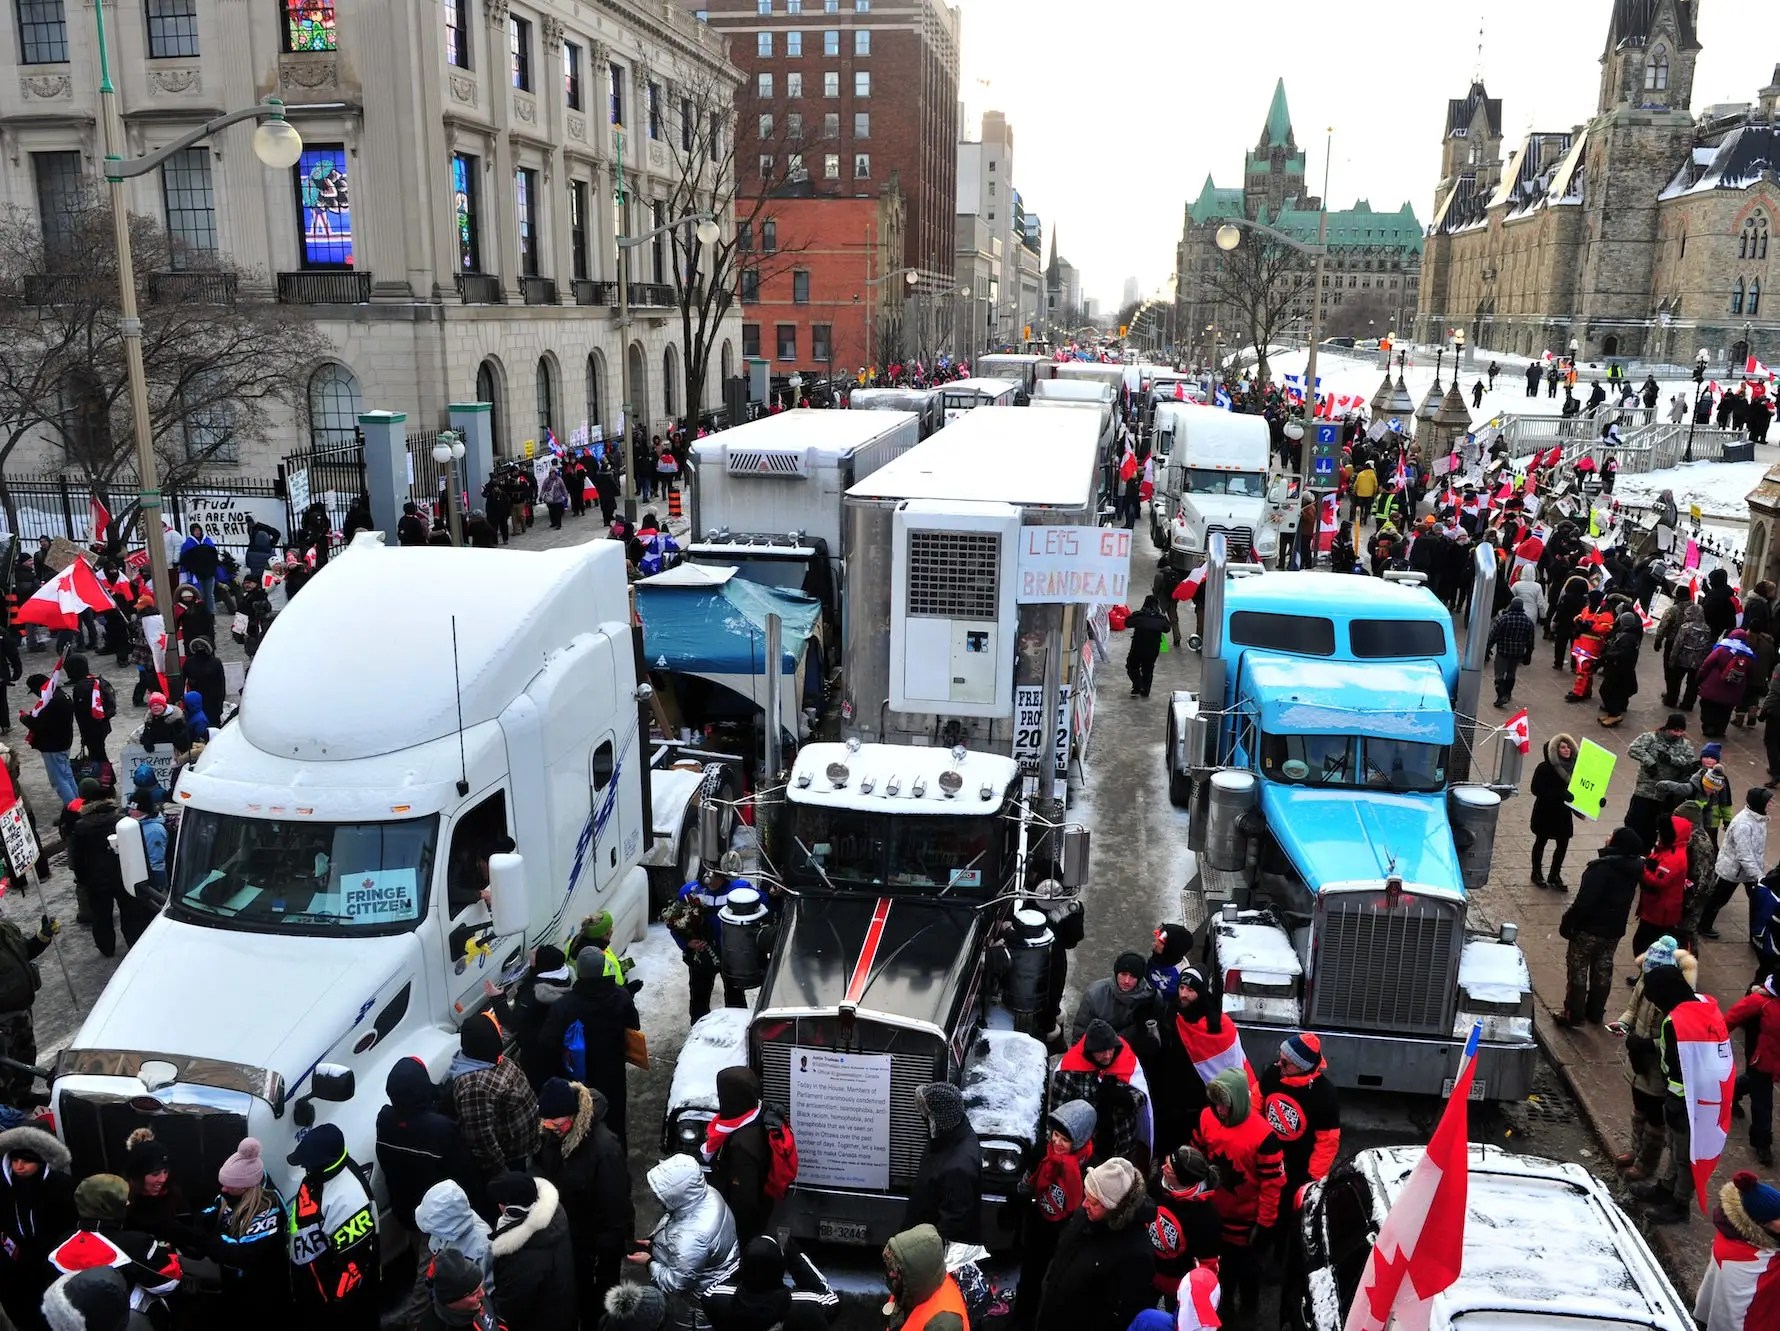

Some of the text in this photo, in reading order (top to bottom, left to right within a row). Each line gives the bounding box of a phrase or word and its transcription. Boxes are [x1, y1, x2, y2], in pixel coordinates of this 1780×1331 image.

[189, 513, 201, 522] WE
[206, 512, 224, 522] ARE
[206, 522, 247, 536] AB RAT
[1100, 532, 1129, 557] GO
[1016, 728, 1068, 748] 202
[1580, 778, 1595, 792] NOT
[346, 886, 406, 903] FRINGE
[346, 898, 412, 916] CITIZEN
[334, 1210, 374, 1250] FXR
